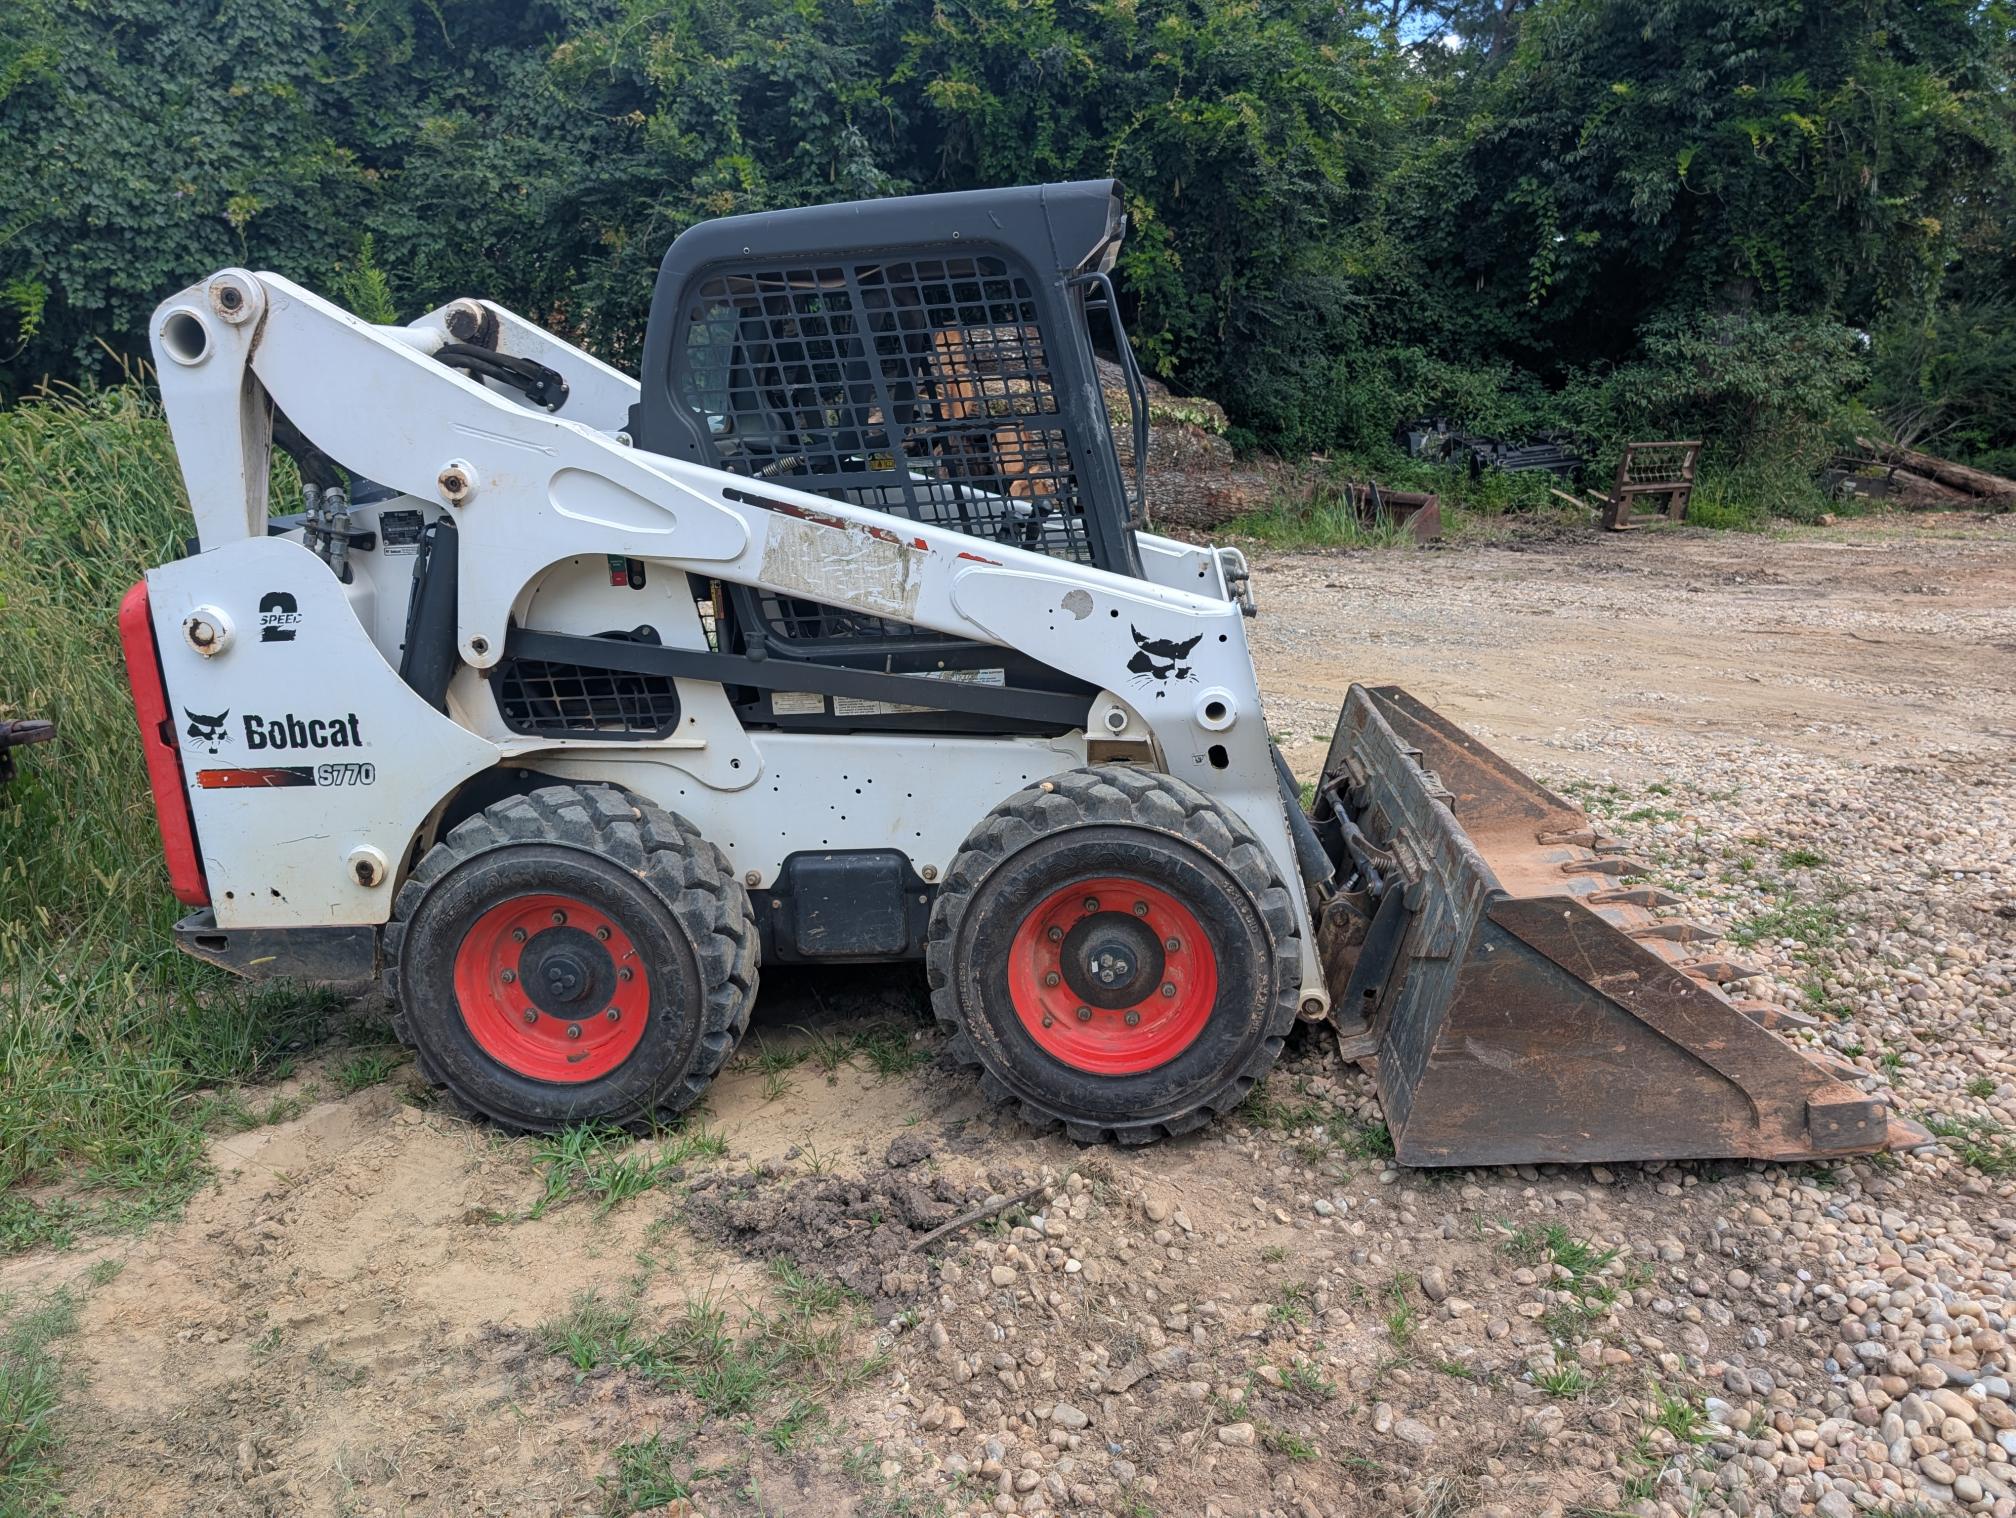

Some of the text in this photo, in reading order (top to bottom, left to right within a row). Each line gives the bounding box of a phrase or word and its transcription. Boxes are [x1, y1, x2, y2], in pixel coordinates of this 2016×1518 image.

[259, 592, 297, 642] 2
[243, 713, 362, 749] Bobcat
[318, 763, 375, 786] S770
